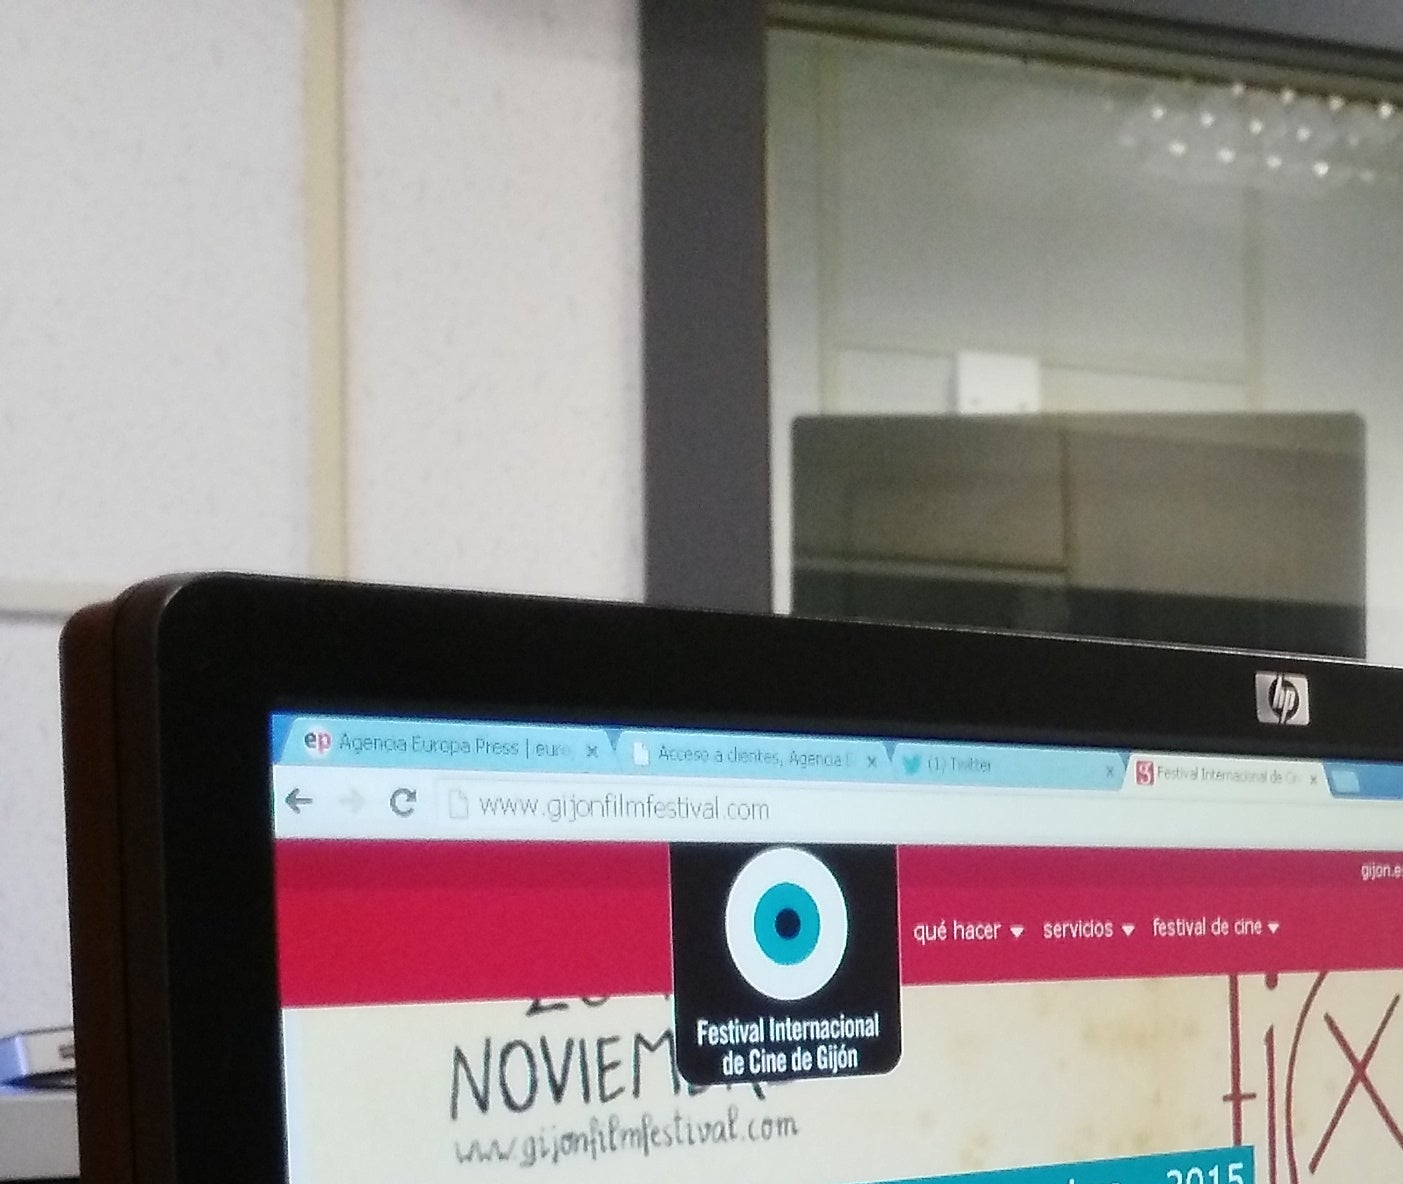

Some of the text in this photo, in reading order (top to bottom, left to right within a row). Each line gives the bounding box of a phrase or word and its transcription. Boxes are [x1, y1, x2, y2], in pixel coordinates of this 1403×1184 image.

[1266, 674, 1301, 725] hp
[340, 732, 519, 756] Agencia Europa Press
[658, 745, 709, 761] Acceso
[789, 750, 842, 768] Agencia
[951, 757, 992, 773] Twitter
[1157, 766, 1283, 784] Festival Internacional de
[479, 795, 770, 822] www.gijonfilmfestival.com
[913, 919, 1002, 946] qué hacer
[1042, 920, 1114, 938] servicios
[1152, 917, 1262, 937] festival de cine
[697, 1013, 880, 1046] Festival Internacional
[722, 1043, 859, 1076] de Cine de Gijón
[454, 1104, 800, 1167] www.gijonfilmfestival.com
